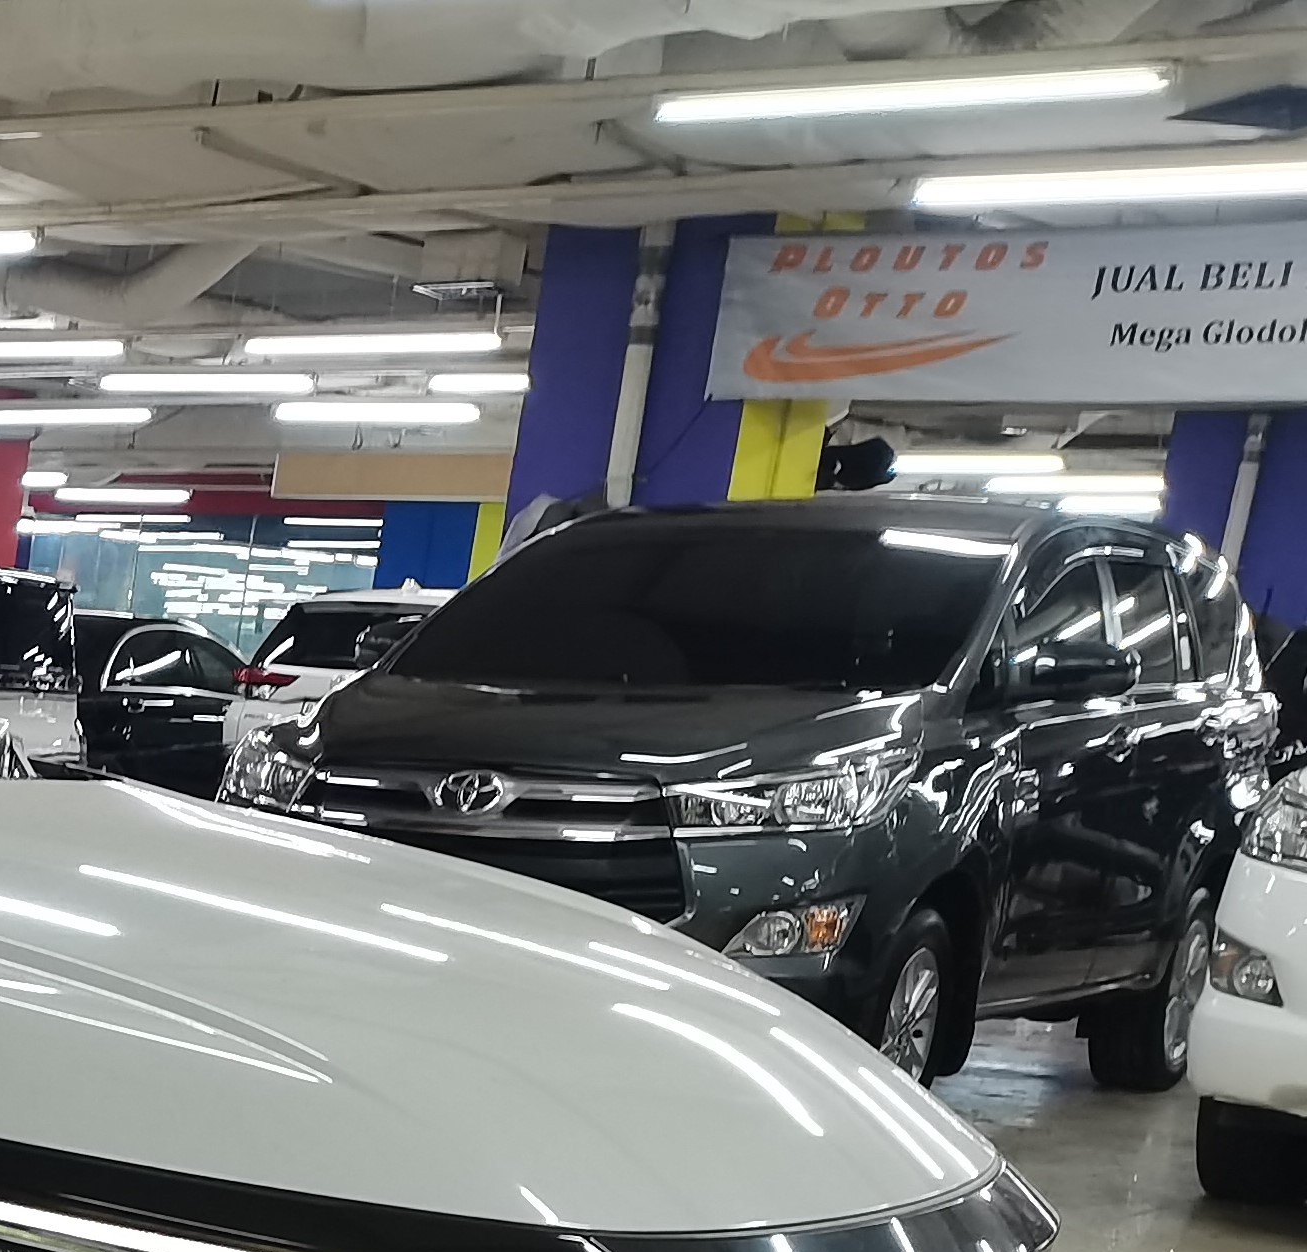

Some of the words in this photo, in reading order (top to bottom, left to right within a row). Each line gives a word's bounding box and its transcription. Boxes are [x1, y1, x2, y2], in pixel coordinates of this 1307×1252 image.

[767, 241, 1049, 273] PLOUTOS
[1091, 264, 1184, 301] JUAL
[1199, 260, 1294, 291] BELI
[812, 285, 969, 320] OTTO
[1109, 321, 1192, 353] Mega
